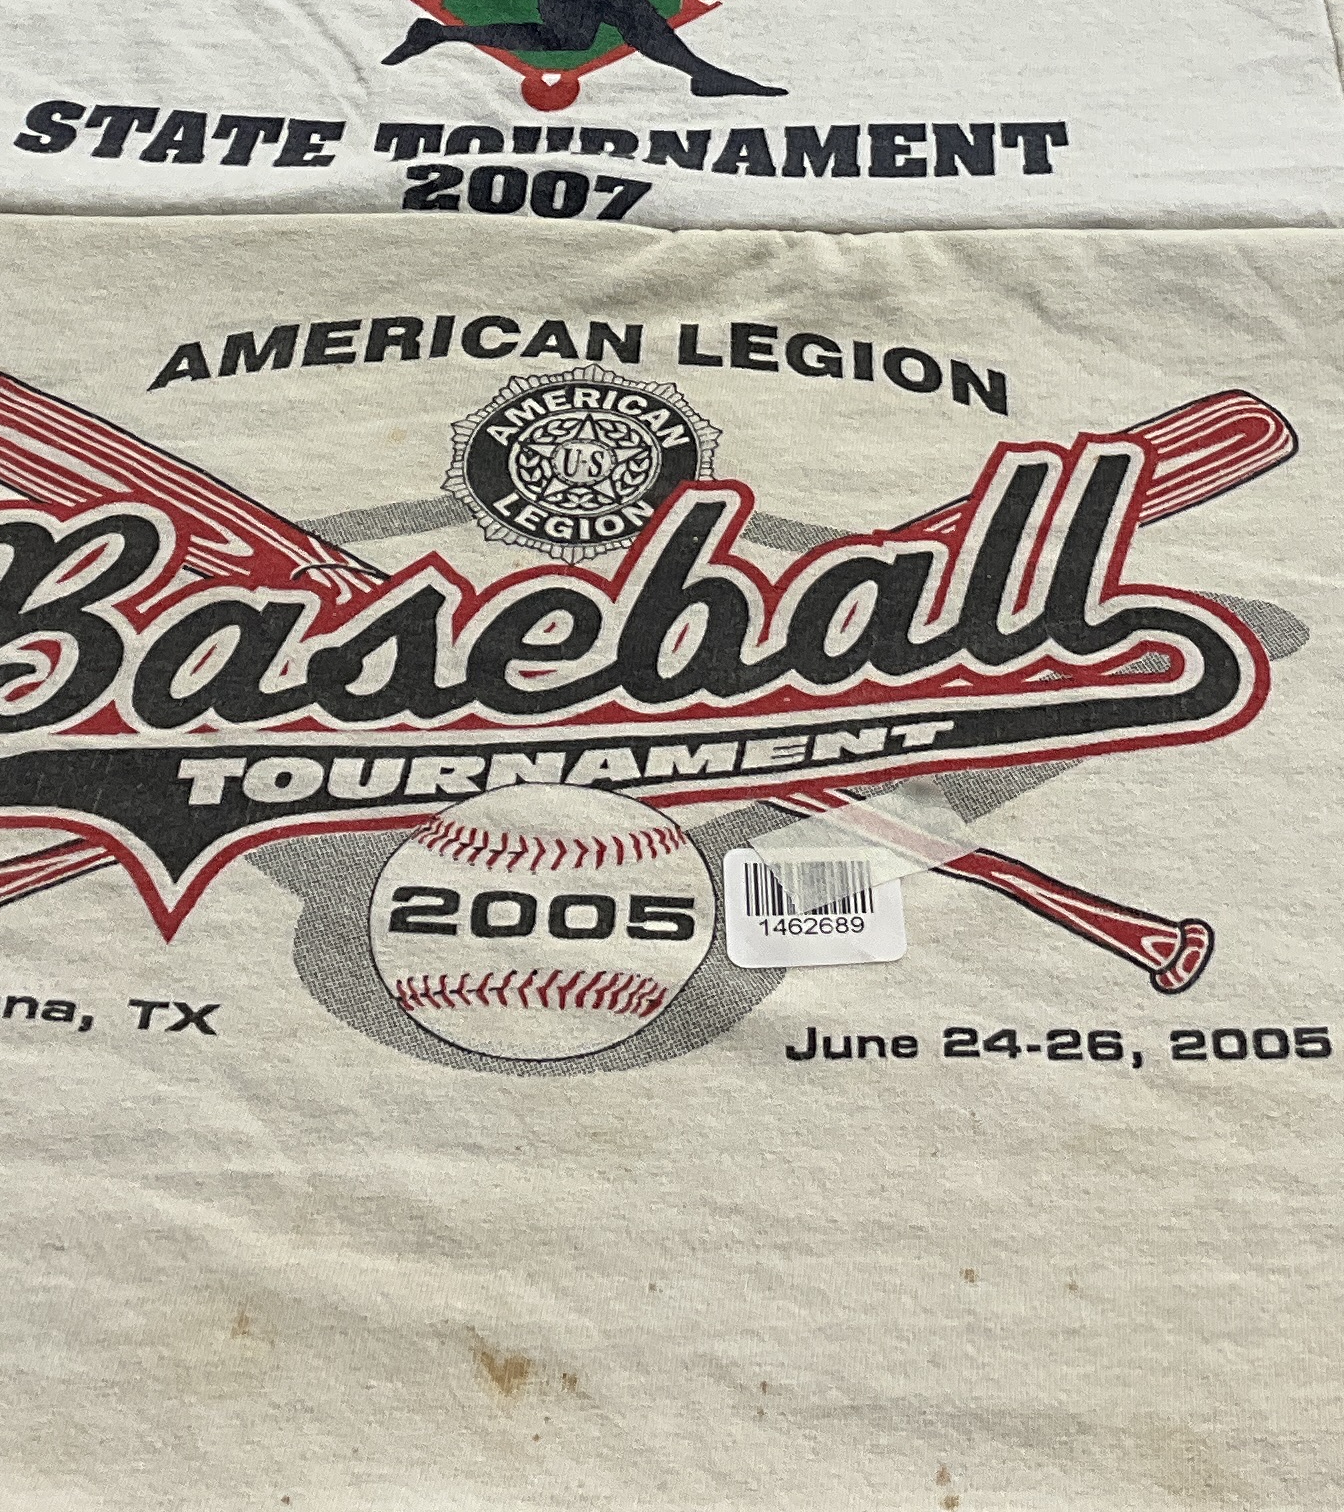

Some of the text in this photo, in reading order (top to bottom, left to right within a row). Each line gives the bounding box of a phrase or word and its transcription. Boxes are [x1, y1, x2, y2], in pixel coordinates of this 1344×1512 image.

[14, 100, 1072, 179] STATE TOURNAMENT
[401, 163, 655, 221] 2007
[147, 315, 1008, 416] AMERICAN LEGION
[486, 387, 690, 449] AMERICAN
[492, 492, 656, 541] LEGION
[177, 718, 956, 806] TOURNAMENT
[388, 886, 696, 941] 2005
[757, 915, 866, 938] 1462689
[128, 999, 220, 1036] TX
[786, 1027, 1332, 1069] June 24-26, 2005
